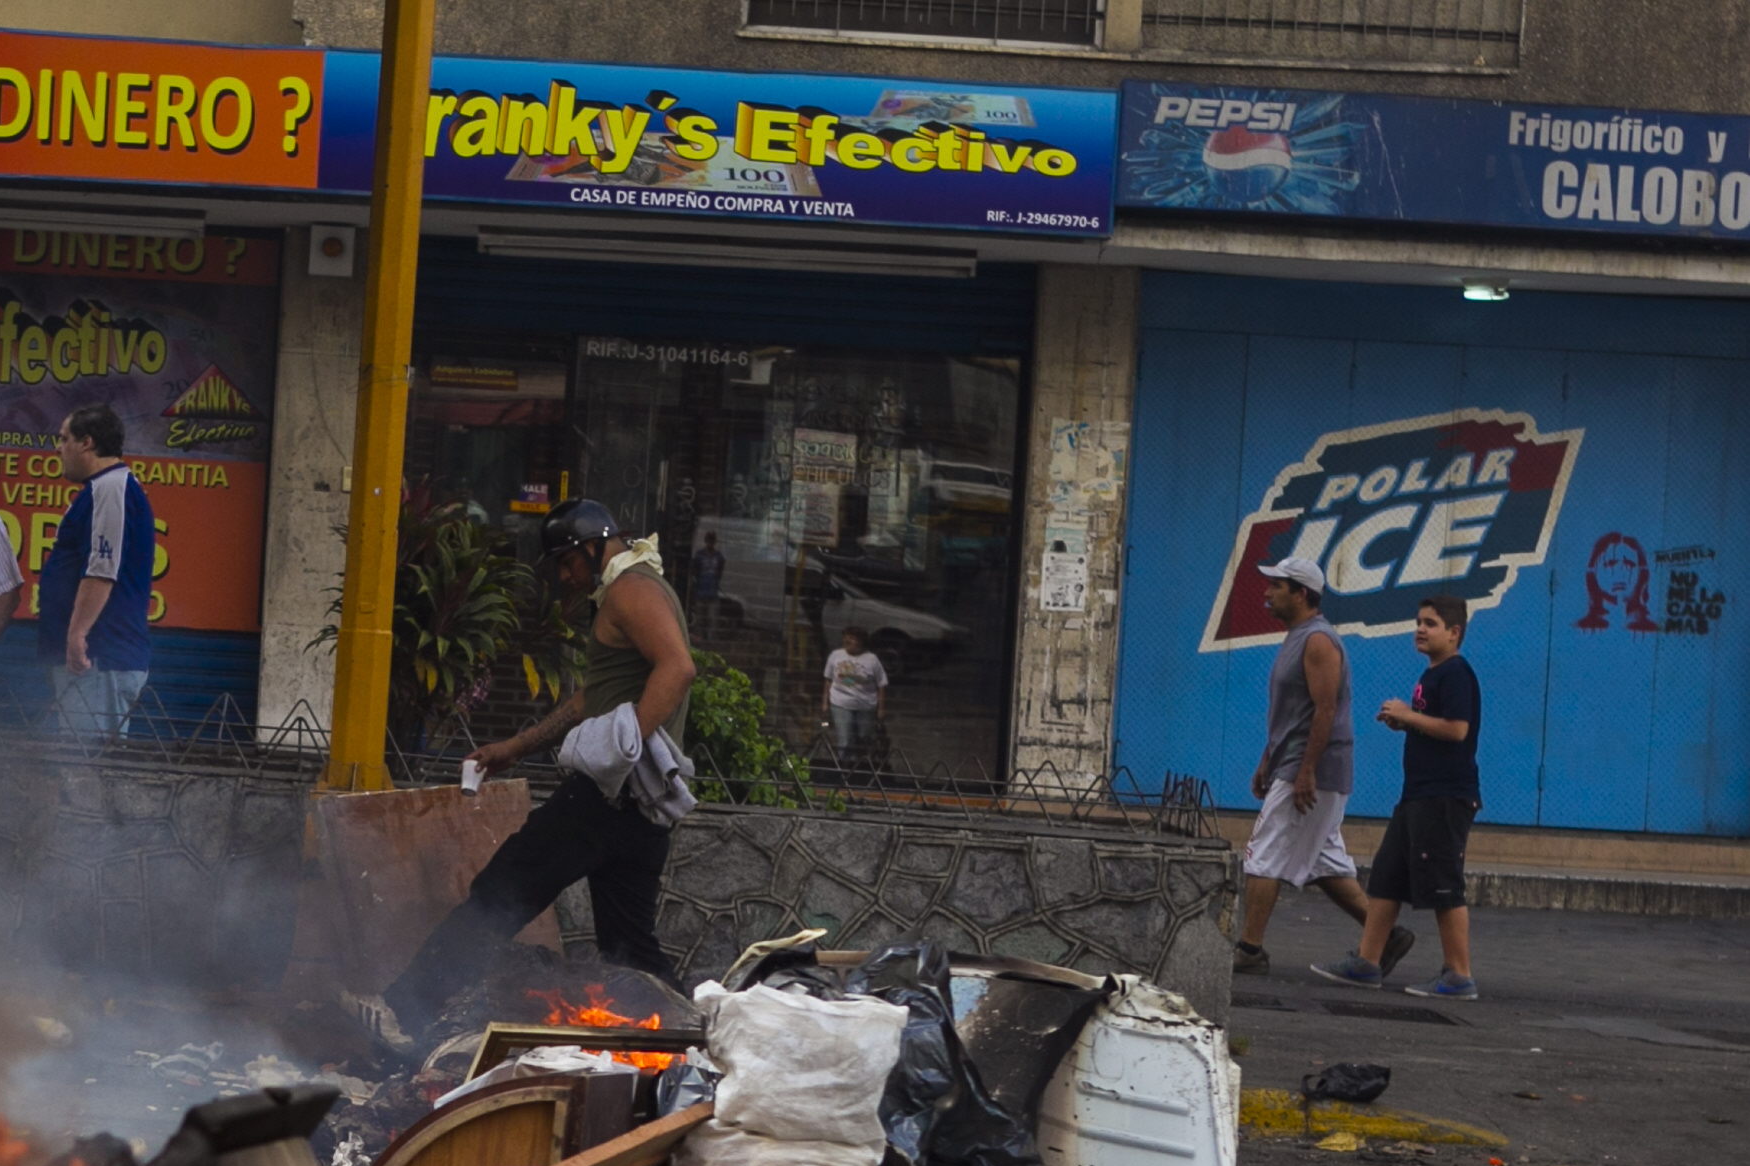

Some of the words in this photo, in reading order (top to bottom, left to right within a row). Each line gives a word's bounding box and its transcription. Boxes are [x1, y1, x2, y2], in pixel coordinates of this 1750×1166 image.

[278, 76, 313, 153] ?
[1154, 96, 1297, 132] PEPSI
[738, 103, 1078, 177] Efectivo
[1508, 110, 1685, 156] Frigorífico
[1707, 130, 1727, 163] y
[723, 167, 786, 184] 100
[1541, 160, 1750, 231] CALOBO
[570, 187, 613, 205] CASA
[616, 189, 637, 206] DE
[641, 187, 710, 210] EMPEÑO
[714, 196, 785, 214] COMPRA
[789, 200, 800, 214] Y
[803, 200, 855, 218] VENTA
[1016, 211, 1100, 229] J-29467970-6
[13, 226, 205, 273] DINERO
[223, 236, 249, 274] ?
[37, 434, 48, 447] Y
[26, 455, 65, 478] CO
[1311, 447, 1517, 513] POLAR
[98, 535, 113, 559] LA
[1288, 490, 1509, 596] ICE
